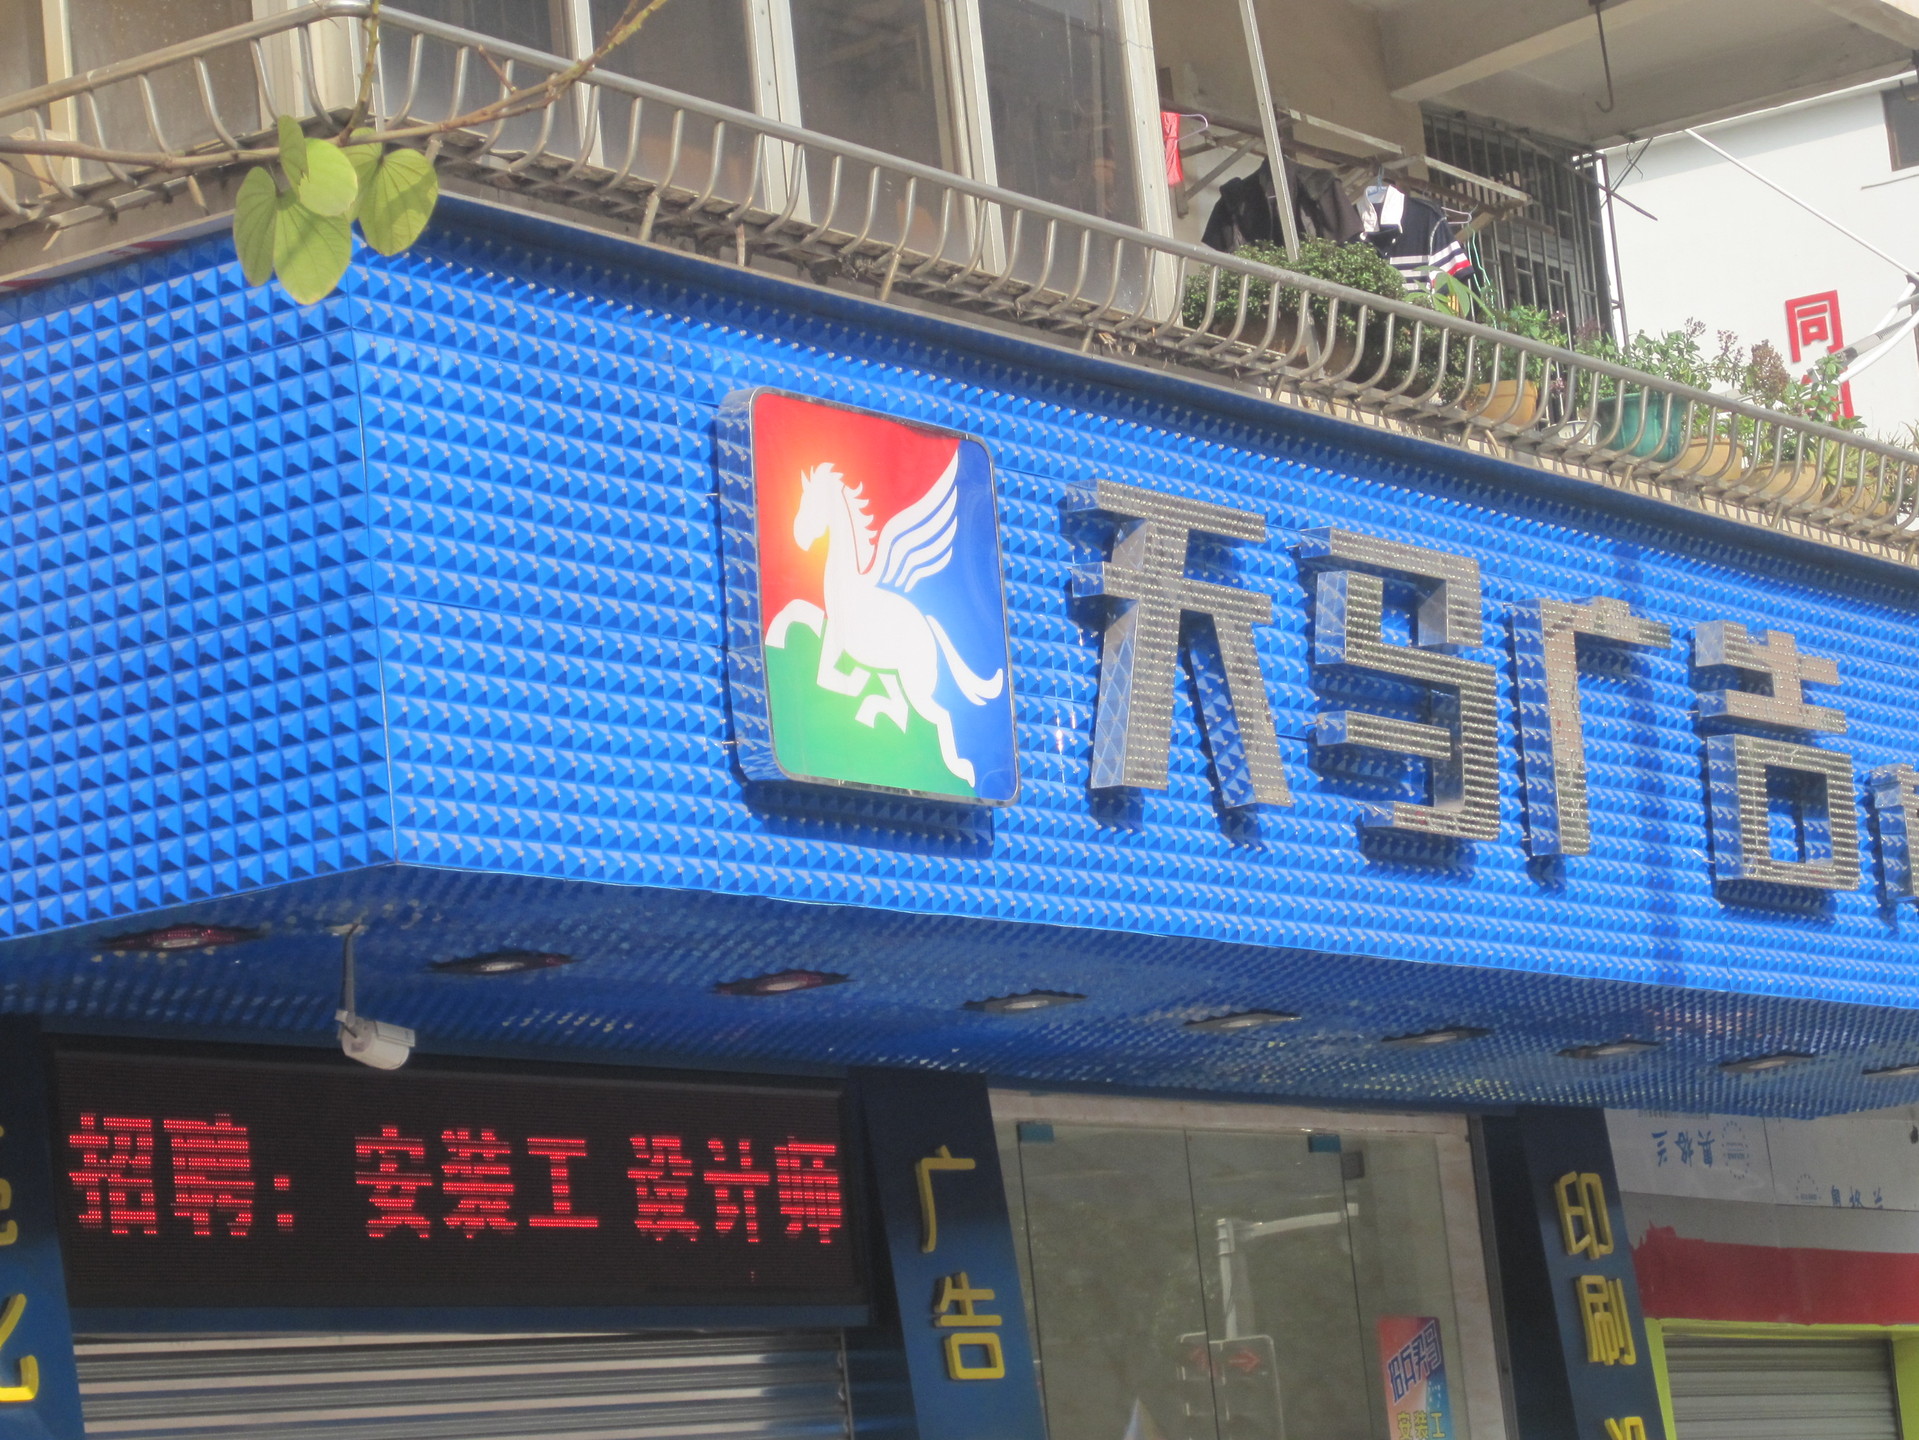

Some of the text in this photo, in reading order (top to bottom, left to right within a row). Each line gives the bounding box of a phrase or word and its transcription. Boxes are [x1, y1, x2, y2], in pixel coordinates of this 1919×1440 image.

[354, 1125, 599, 1239] 安装工
[627, 1134, 842, 1244] 设计师
[916, 1144, 1006, 1381] 广告
